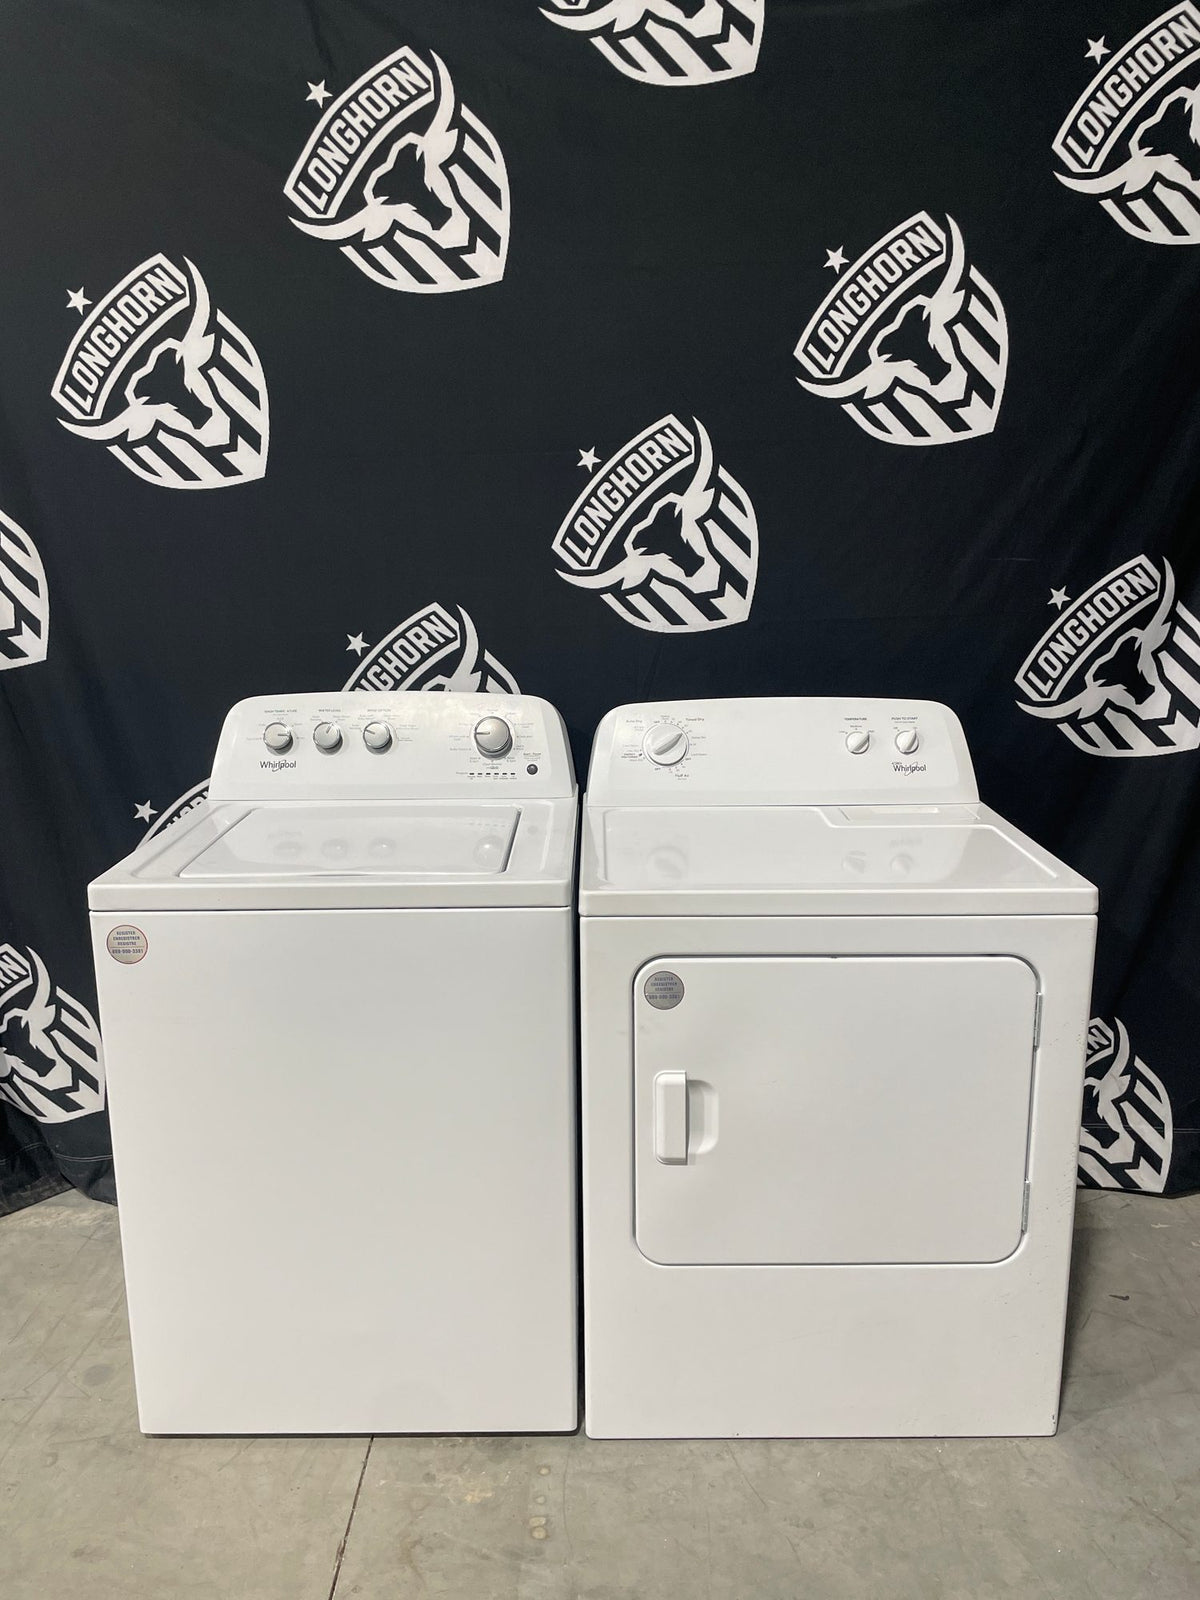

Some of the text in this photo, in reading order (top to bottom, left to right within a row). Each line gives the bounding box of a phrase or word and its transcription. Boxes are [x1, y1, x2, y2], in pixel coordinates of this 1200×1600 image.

[298, 61, 429, 211] LONGHORN
[1066, 14, 1200, 166] LONGHORN
[64, 267, 185, 413] LONGHORN
[806, 223, 942, 371] LONGHORN
[565, 427, 690, 564] LONGHORN
[1027, 566, 1156, 695] LONGHORN
[259, 760, 297, 772] Whirlpool
[893, 762, 927, 776] Whirlpool
